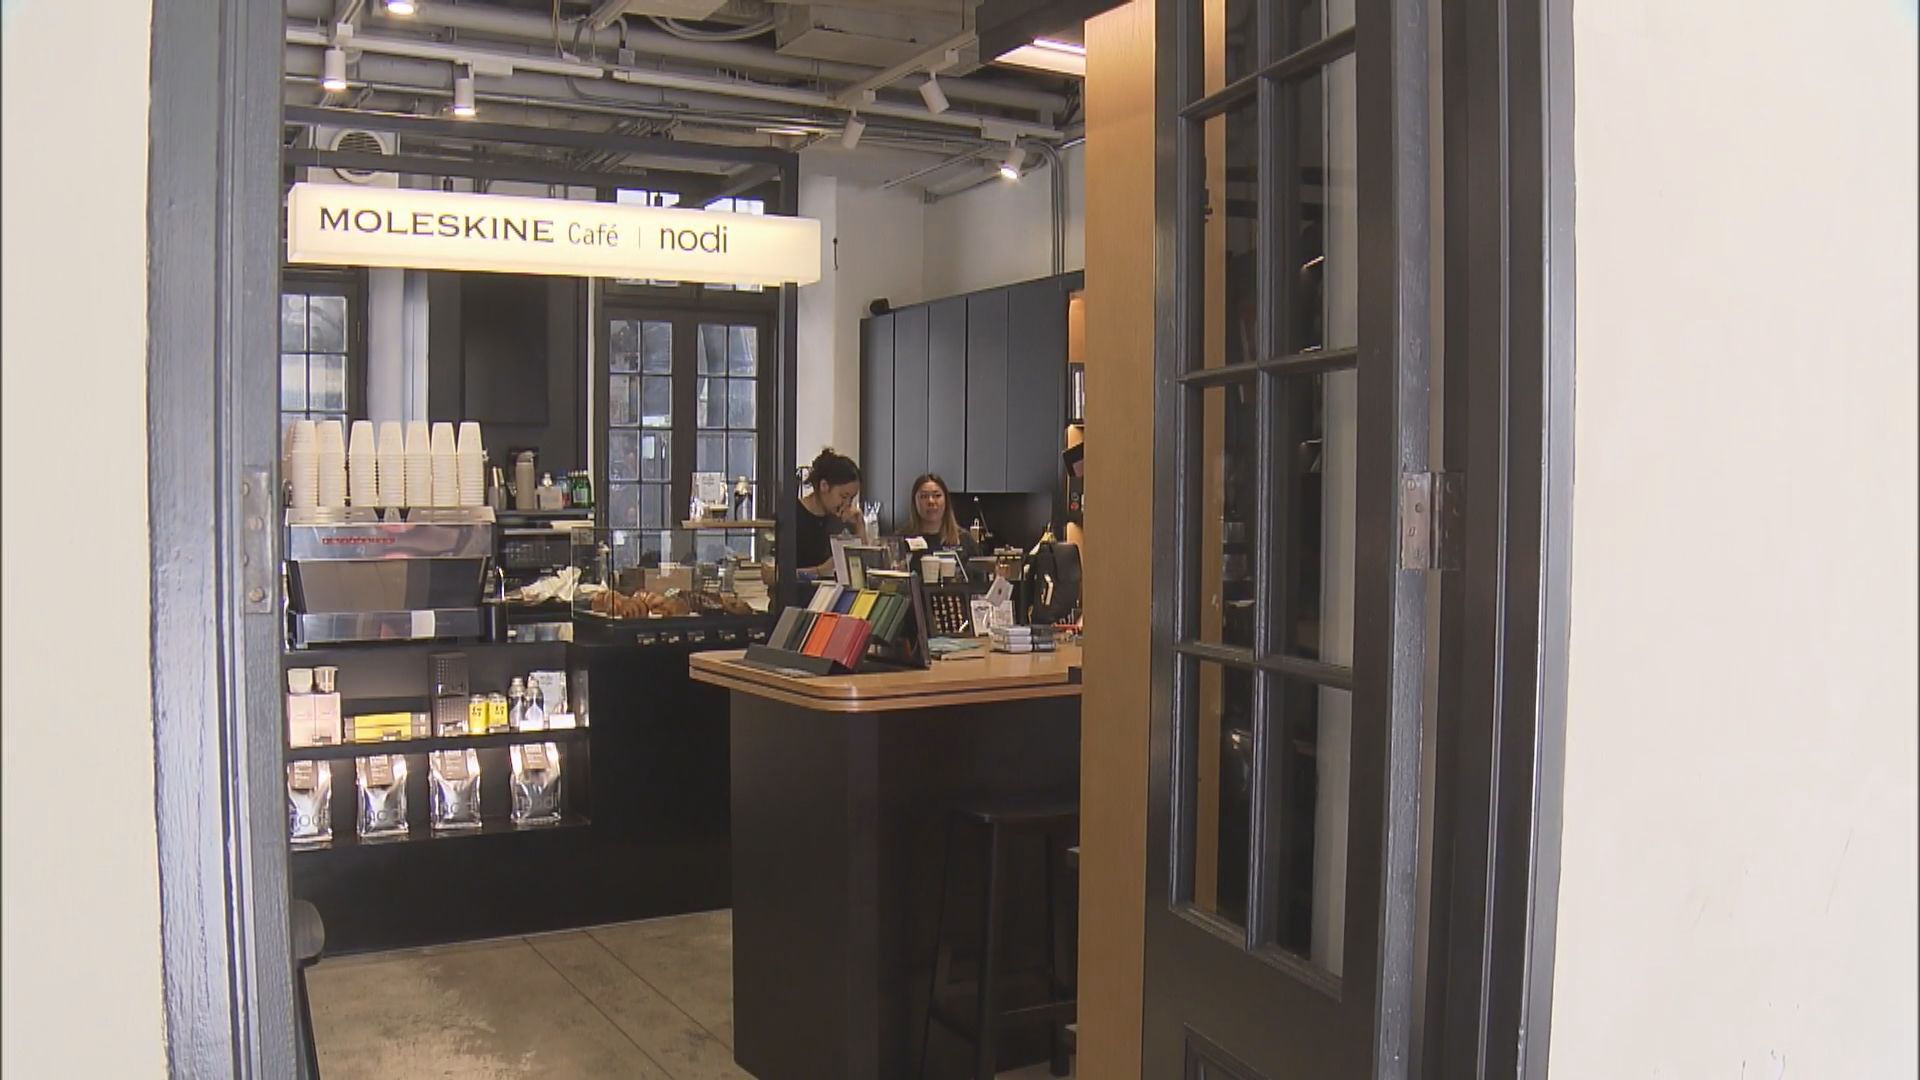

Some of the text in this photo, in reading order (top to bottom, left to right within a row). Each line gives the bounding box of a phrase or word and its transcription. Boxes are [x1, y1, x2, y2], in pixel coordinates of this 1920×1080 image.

[320, 207, 727, 254] MOLESKINE Café nodi
